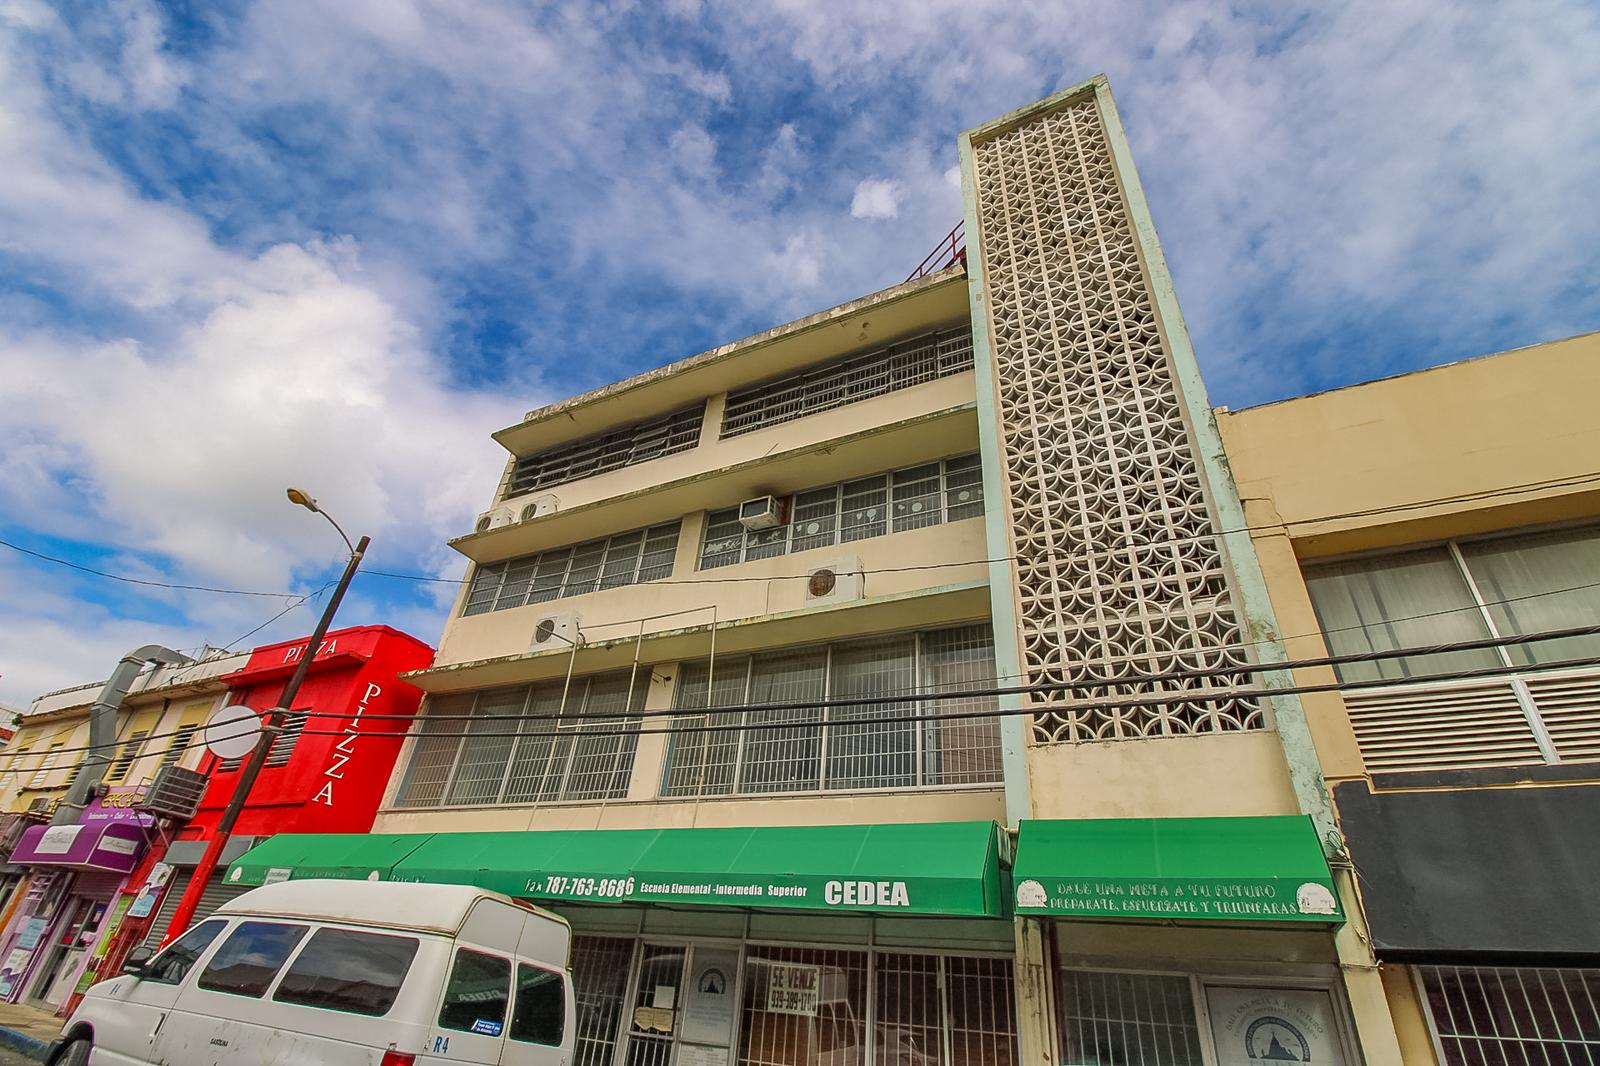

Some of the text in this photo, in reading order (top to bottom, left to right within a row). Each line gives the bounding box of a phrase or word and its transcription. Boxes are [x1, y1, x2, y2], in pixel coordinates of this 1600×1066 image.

[283, 639, 337, 664] PIZA
[312, 683, 382, 806] PIZZA
[545, 876, 635, 898] 787-763-8686
[640, 882, 670, 894] Escuela
[671, 883, 711, 895] Elemental
[768, 885, 808, 898] Superior
[824, 880, 910, 906] CEDEA
[1057, 882, 1092, 896] DALE
[1095, 883, 1124, 896] UNA
[1129, 883, 1169, 897] META
[1174, 885, 1184, 897] A
[1188, 884, 1211, 897] TU
[1215, 884, 1276, 898] FUTURO
[1200, 901, 1209, 913] Y
[1213, 901, 1297, 915] TRIUNFARAS
[772, 967, 817, 990] SE VENDE
[433, 1036, 450, 1054] R4
